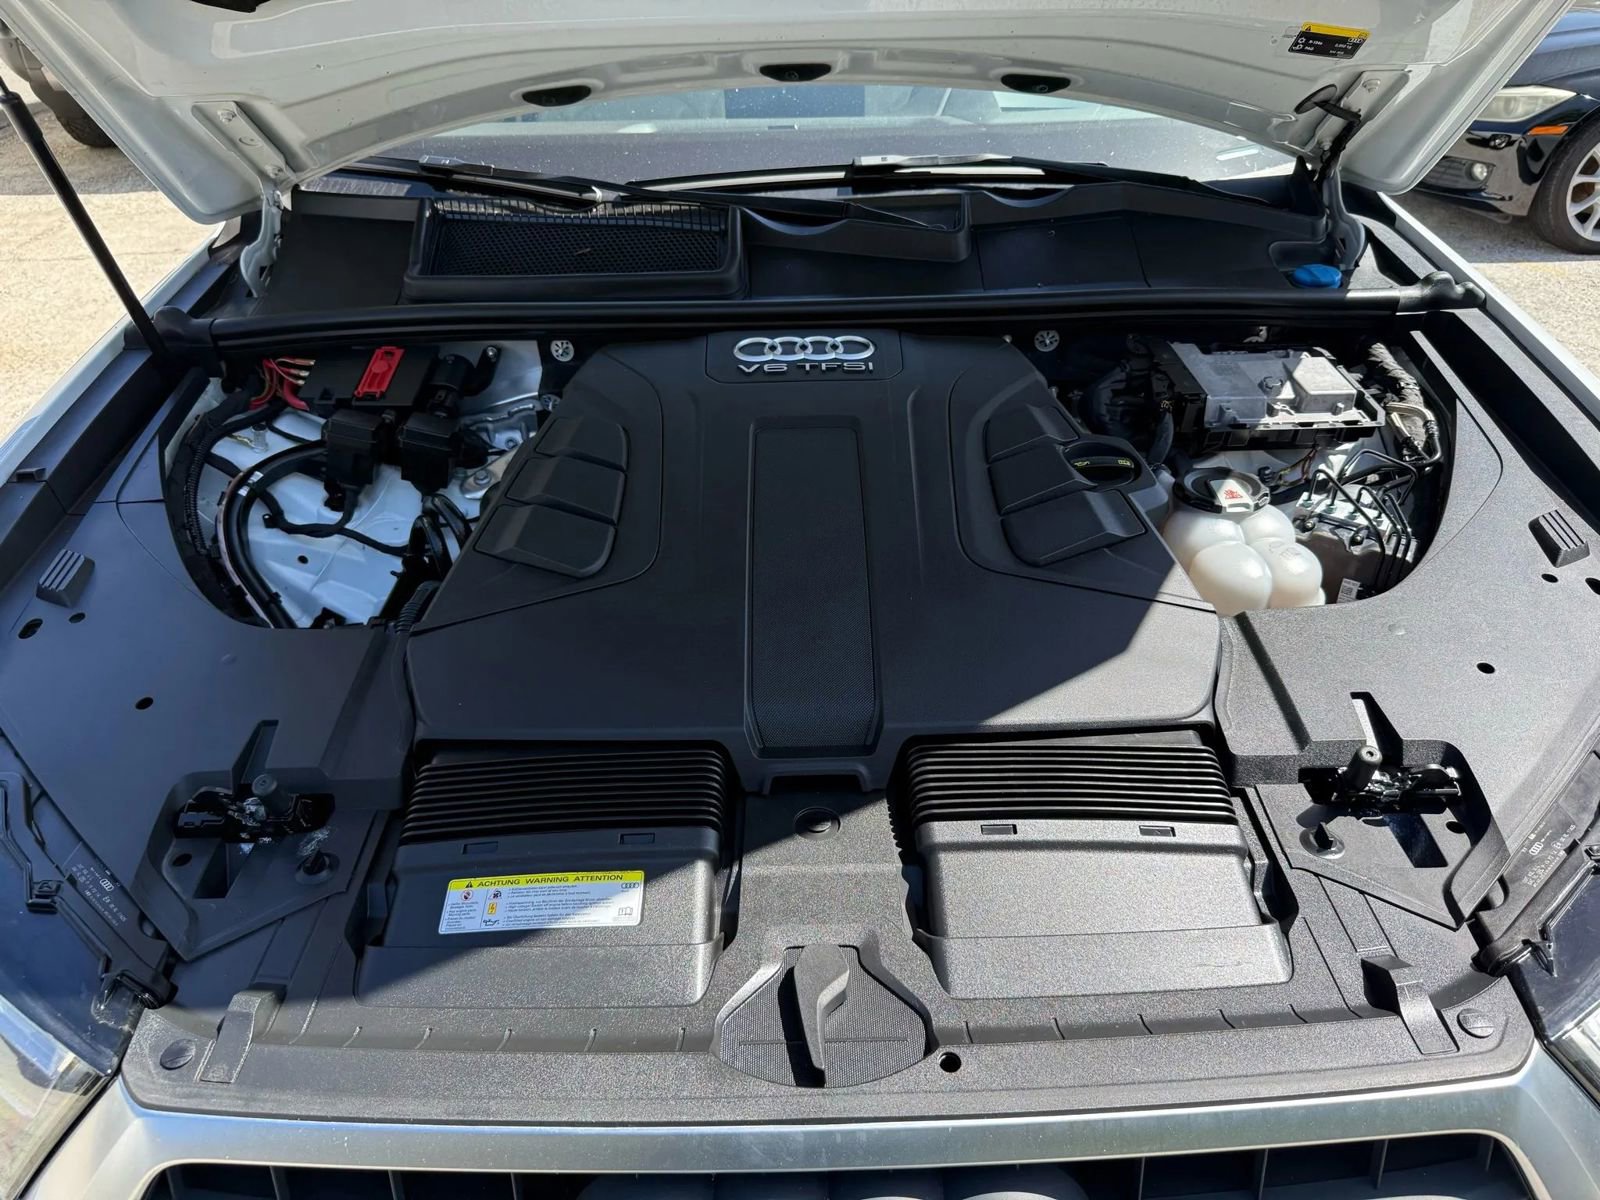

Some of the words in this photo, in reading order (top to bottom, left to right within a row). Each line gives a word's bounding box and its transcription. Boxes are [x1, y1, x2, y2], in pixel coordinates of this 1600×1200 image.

[738, 363, 788, 373] V6
[797, 361, 874, 372] TFSI
[477, 878, 520, 888] ACHTUNG
[525, 875, 569, 884] WARNING
[574, 873, 624, 882] ATTENTION
